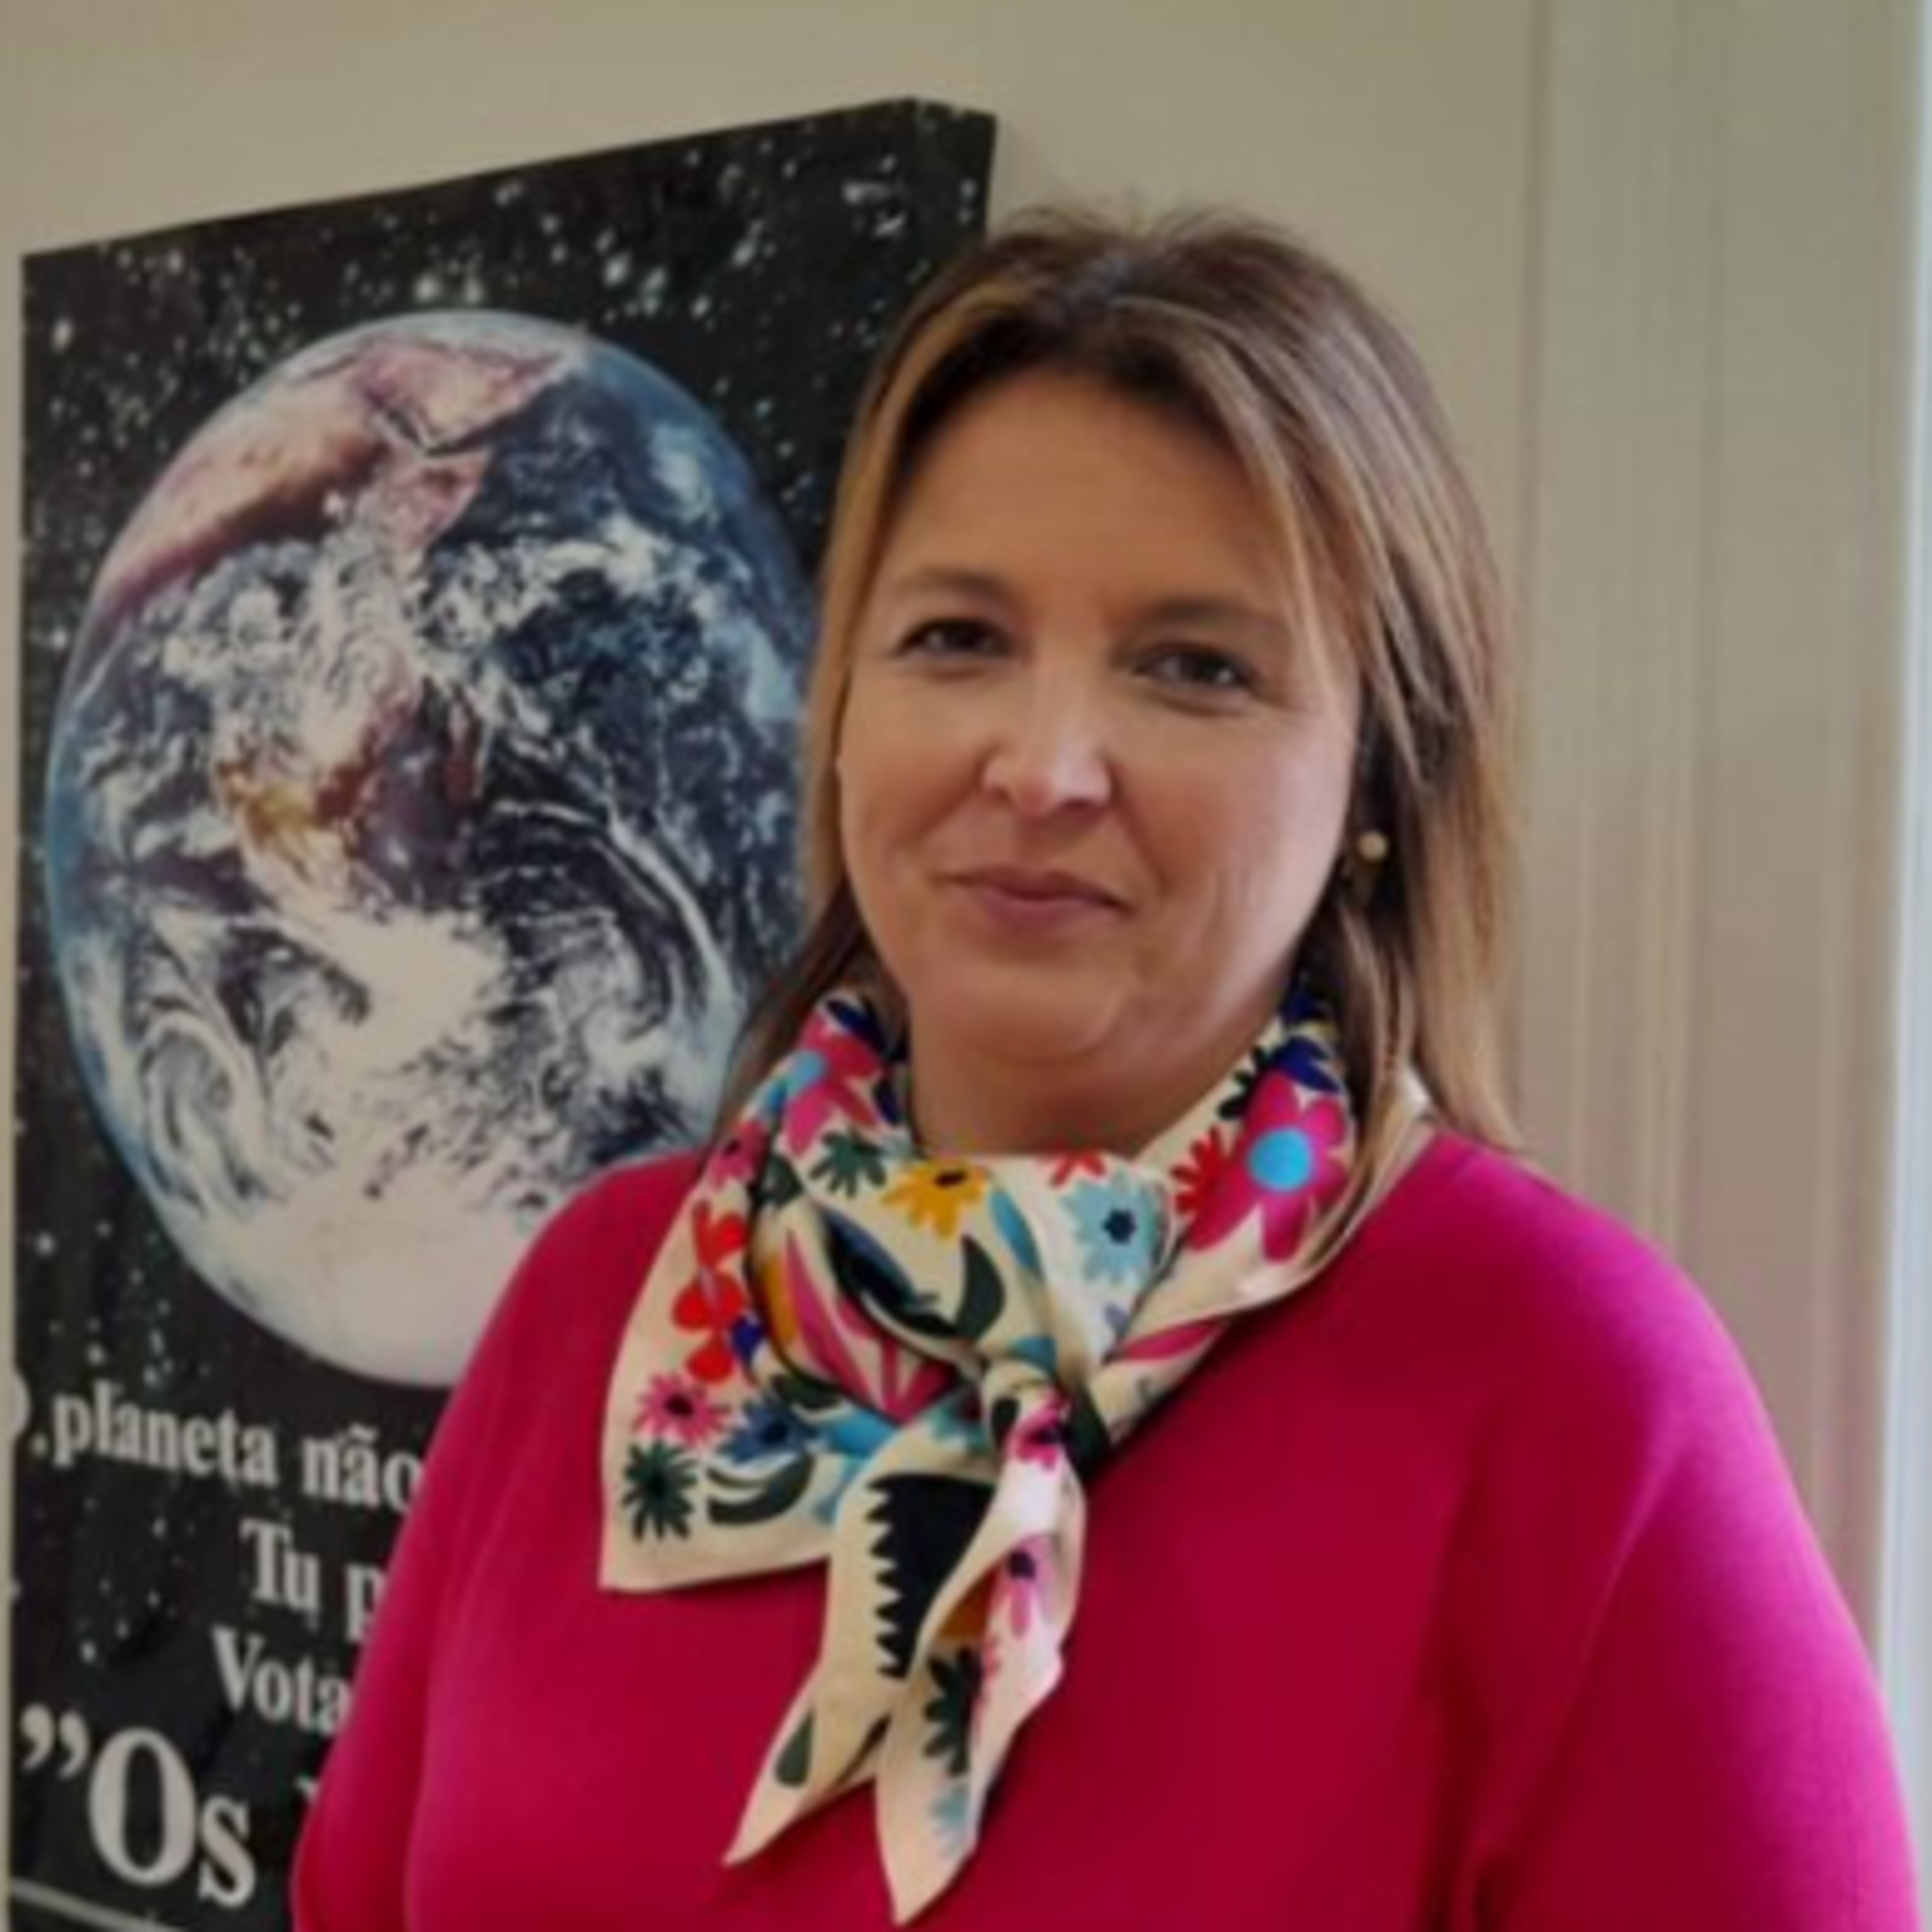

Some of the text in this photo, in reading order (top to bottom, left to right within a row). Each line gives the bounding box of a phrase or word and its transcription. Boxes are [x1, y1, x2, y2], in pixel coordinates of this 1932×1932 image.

[53, 1378, 279, 1488] planeta
[302, 1422, 424, 1513] não
[240, 1516, 322, 1614] Tu
